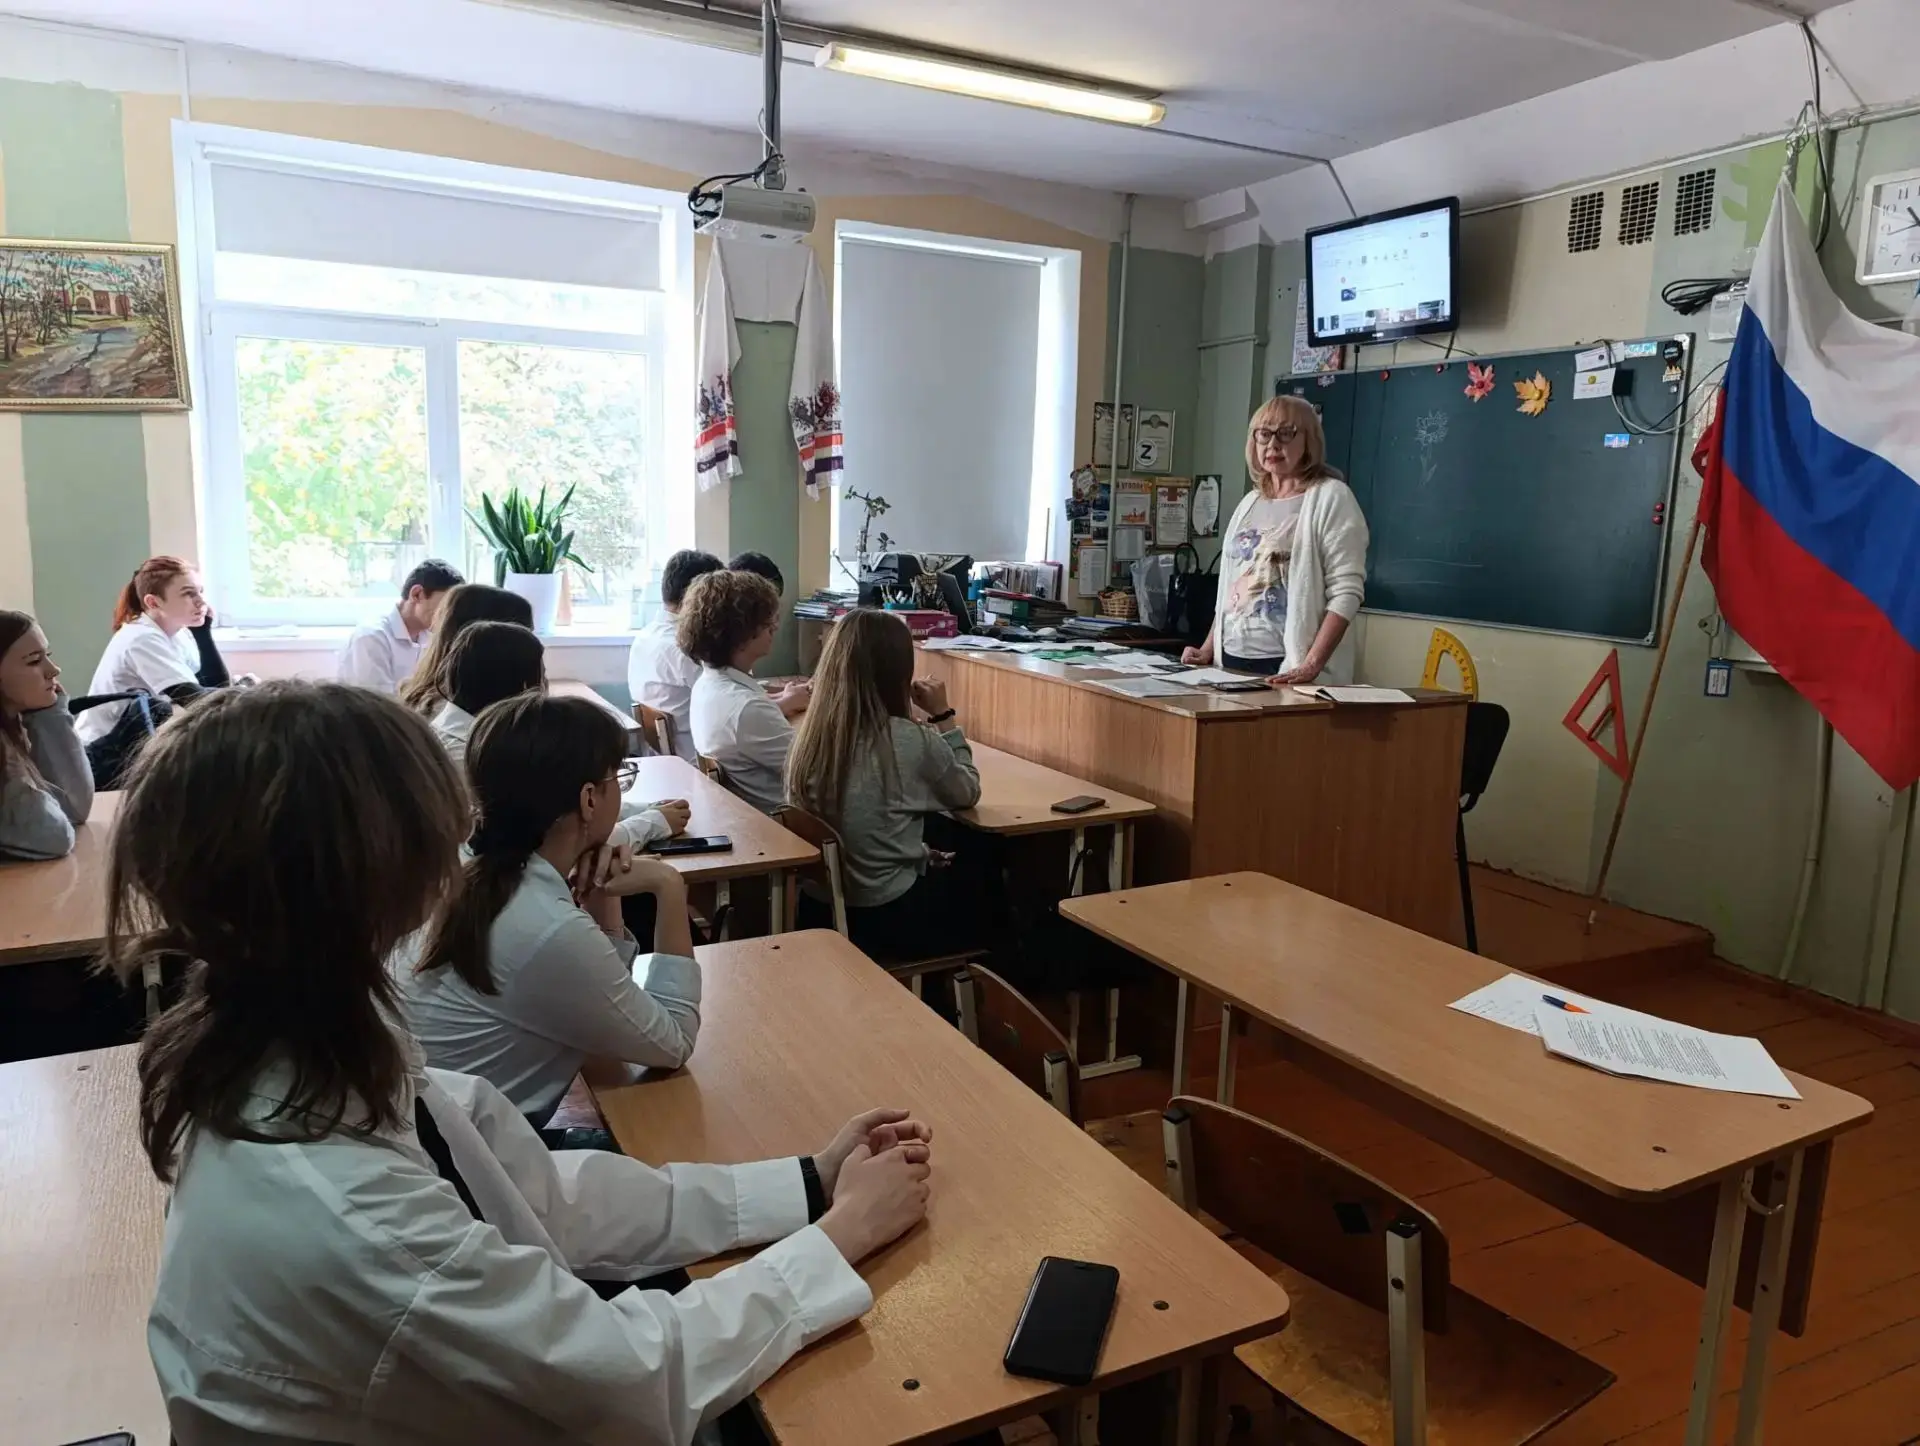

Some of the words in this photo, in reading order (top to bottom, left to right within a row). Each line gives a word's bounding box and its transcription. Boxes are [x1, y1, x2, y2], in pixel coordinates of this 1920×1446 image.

[1898, 187, 1908, 200] 11
[1883, 203, 1896, 216] 10
[1892, 254, 1901, 266] 7
[1140, 444, 1152, 459] Z
